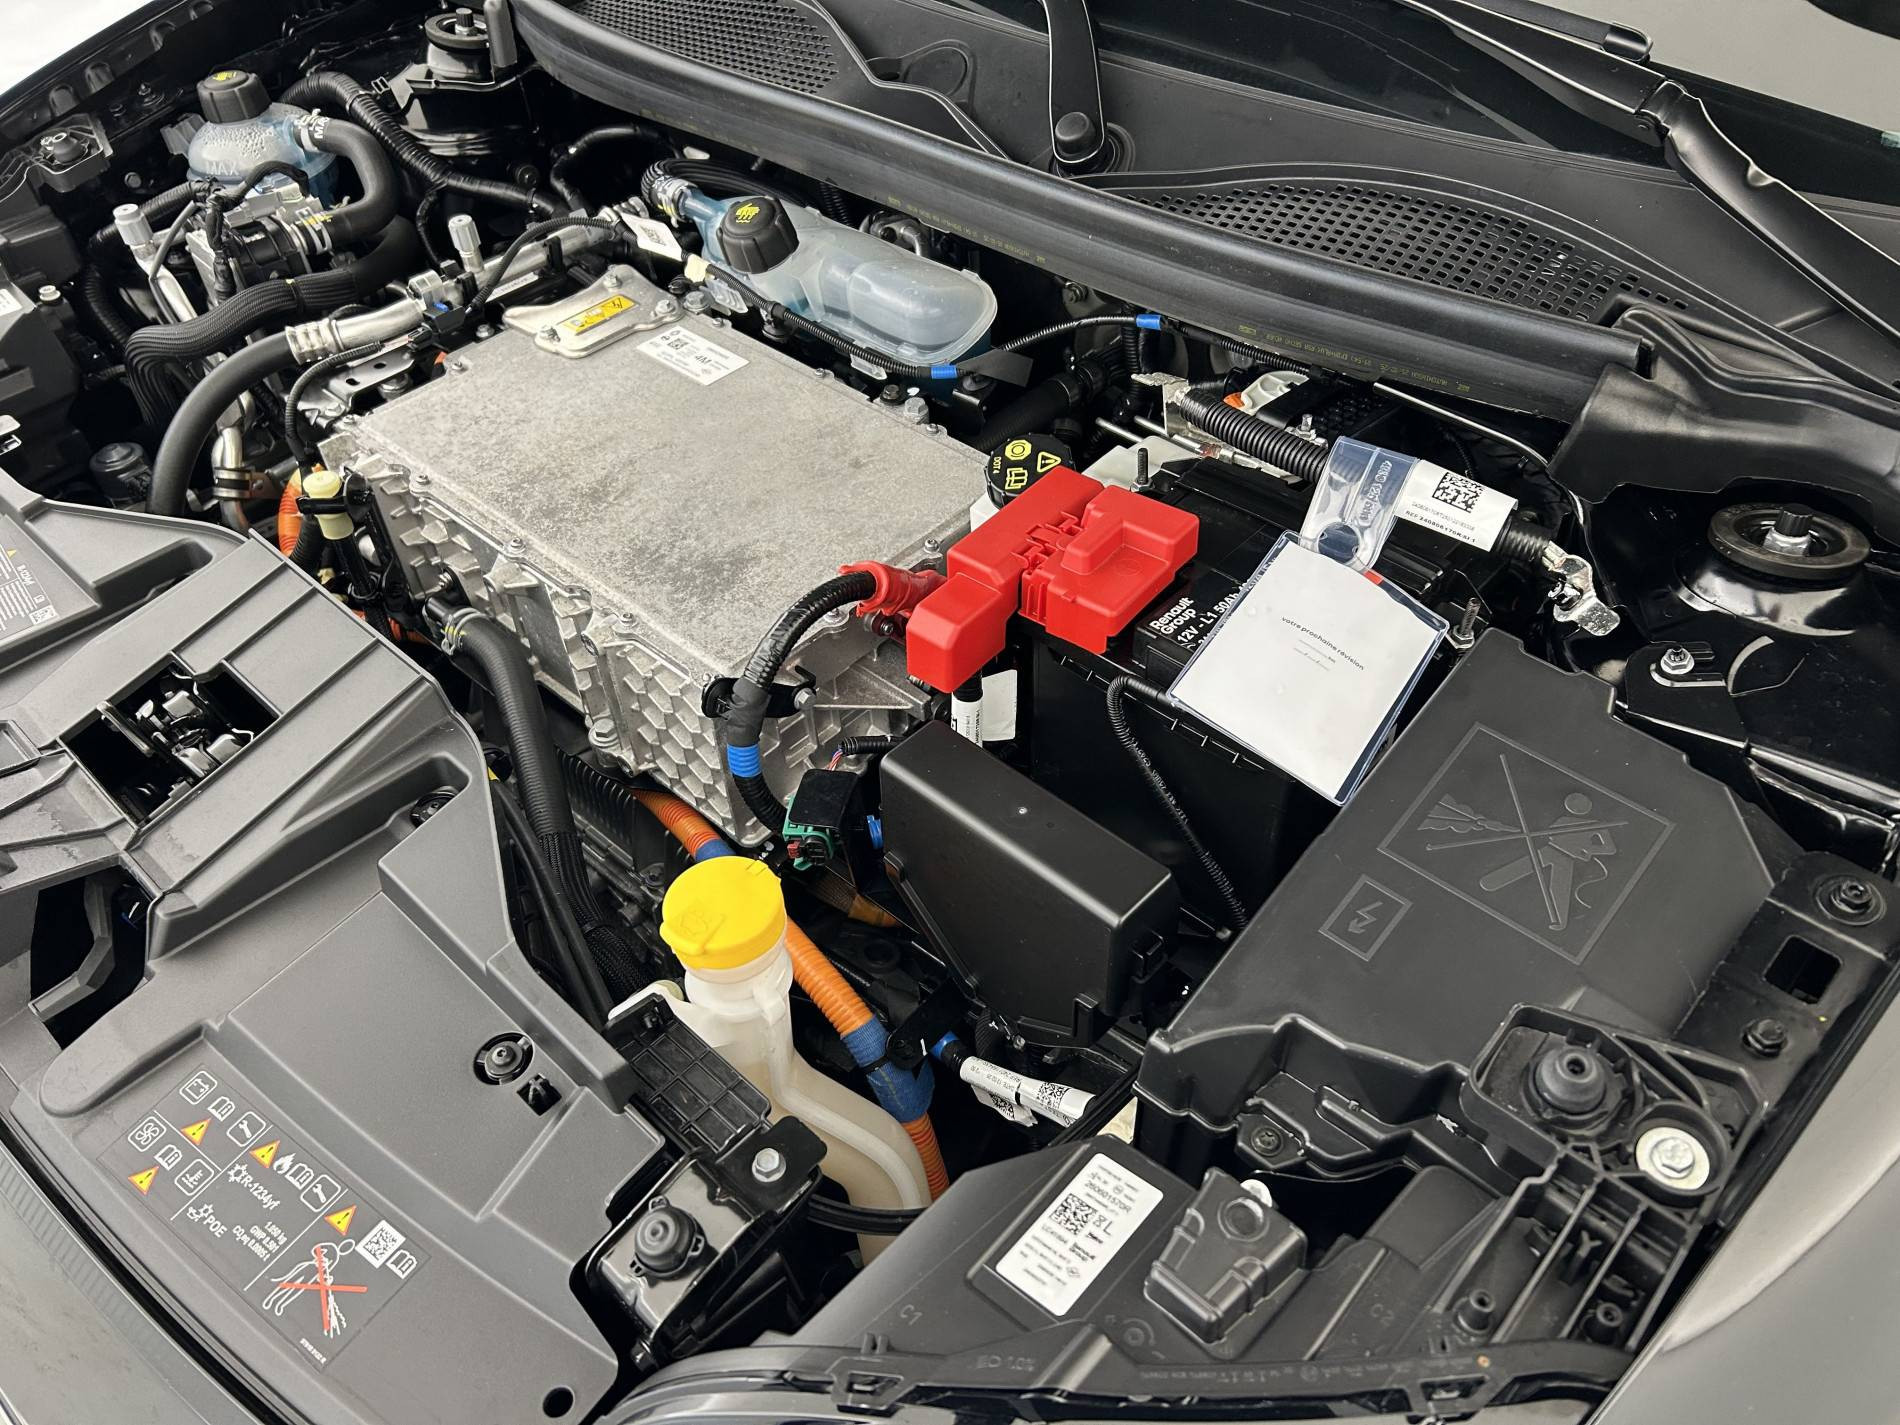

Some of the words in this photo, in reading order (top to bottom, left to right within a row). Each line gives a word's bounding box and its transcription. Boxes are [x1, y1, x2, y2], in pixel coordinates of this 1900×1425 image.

[205, 161, 240, 176] MAX
[992, 456, 1002, 469] DOT
[1149, 597, 1195, 630] Renault
[1160, 608, 1197, 635] Group
[1177, 625, 1199, 643] 12V
[1199, 611, 1218, 625] L1
[1213, 592, 1240, 614] 50Ah
[1282, 616, 1301, 629] votre
[1301, 627, 1337, 651] prochaine
[241, 1174, 280, 1210] R-1234yf
[203, 1214, 228, 1238] POE
[250, 1225, 266, 1240] GWP
[277, 1232, 288, 1245] kg
